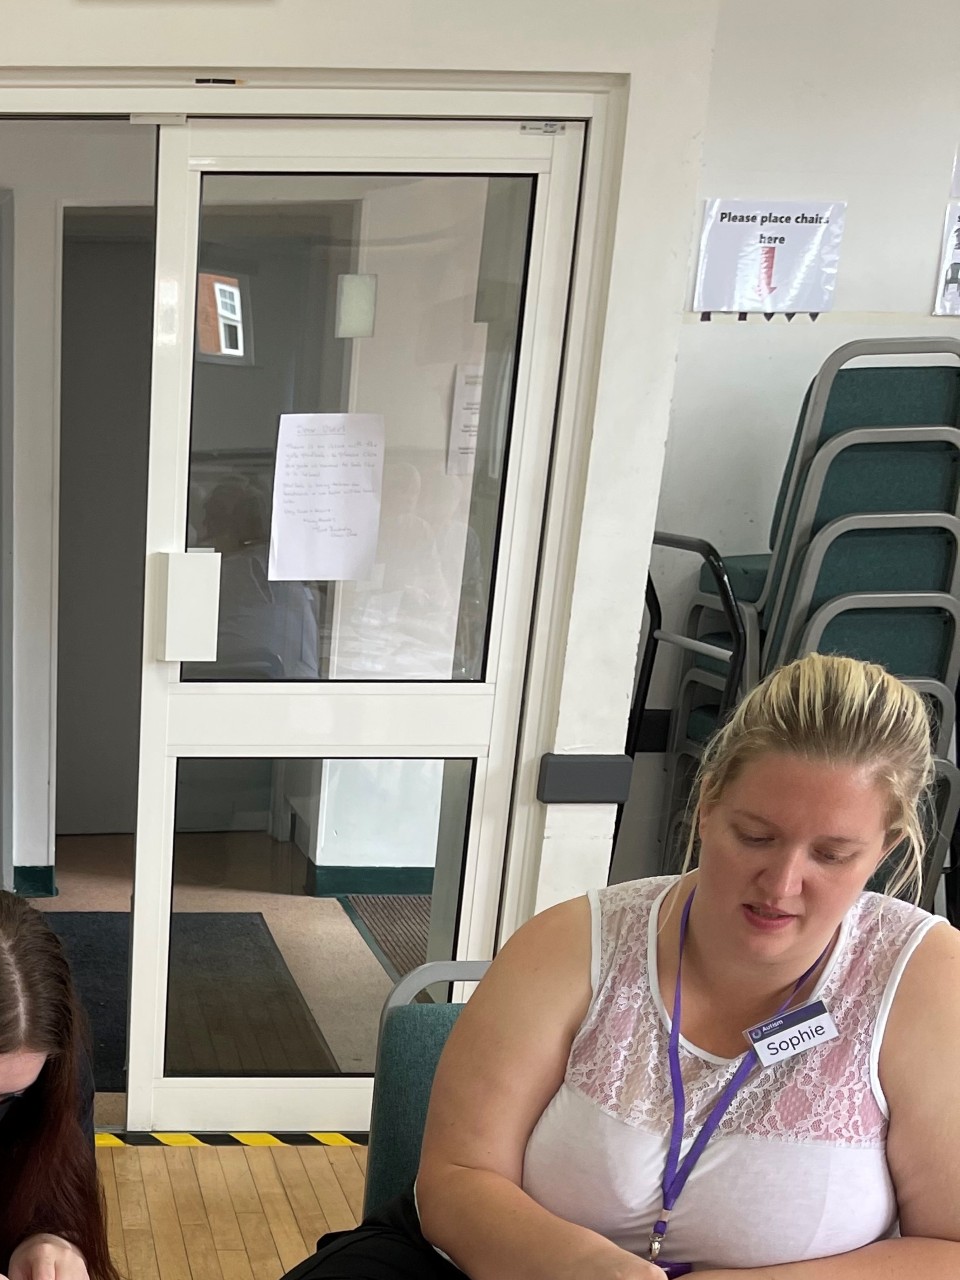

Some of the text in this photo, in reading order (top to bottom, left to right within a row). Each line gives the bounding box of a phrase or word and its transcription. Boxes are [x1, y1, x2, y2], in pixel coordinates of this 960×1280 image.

[720, 212, 757, 223] Please
[761, 214, 791, 225] place
[759, 234, 785, 244] here
[762, 1019, 783, 1032] Autism
[767, 1025, 825, 1055] Sophie
